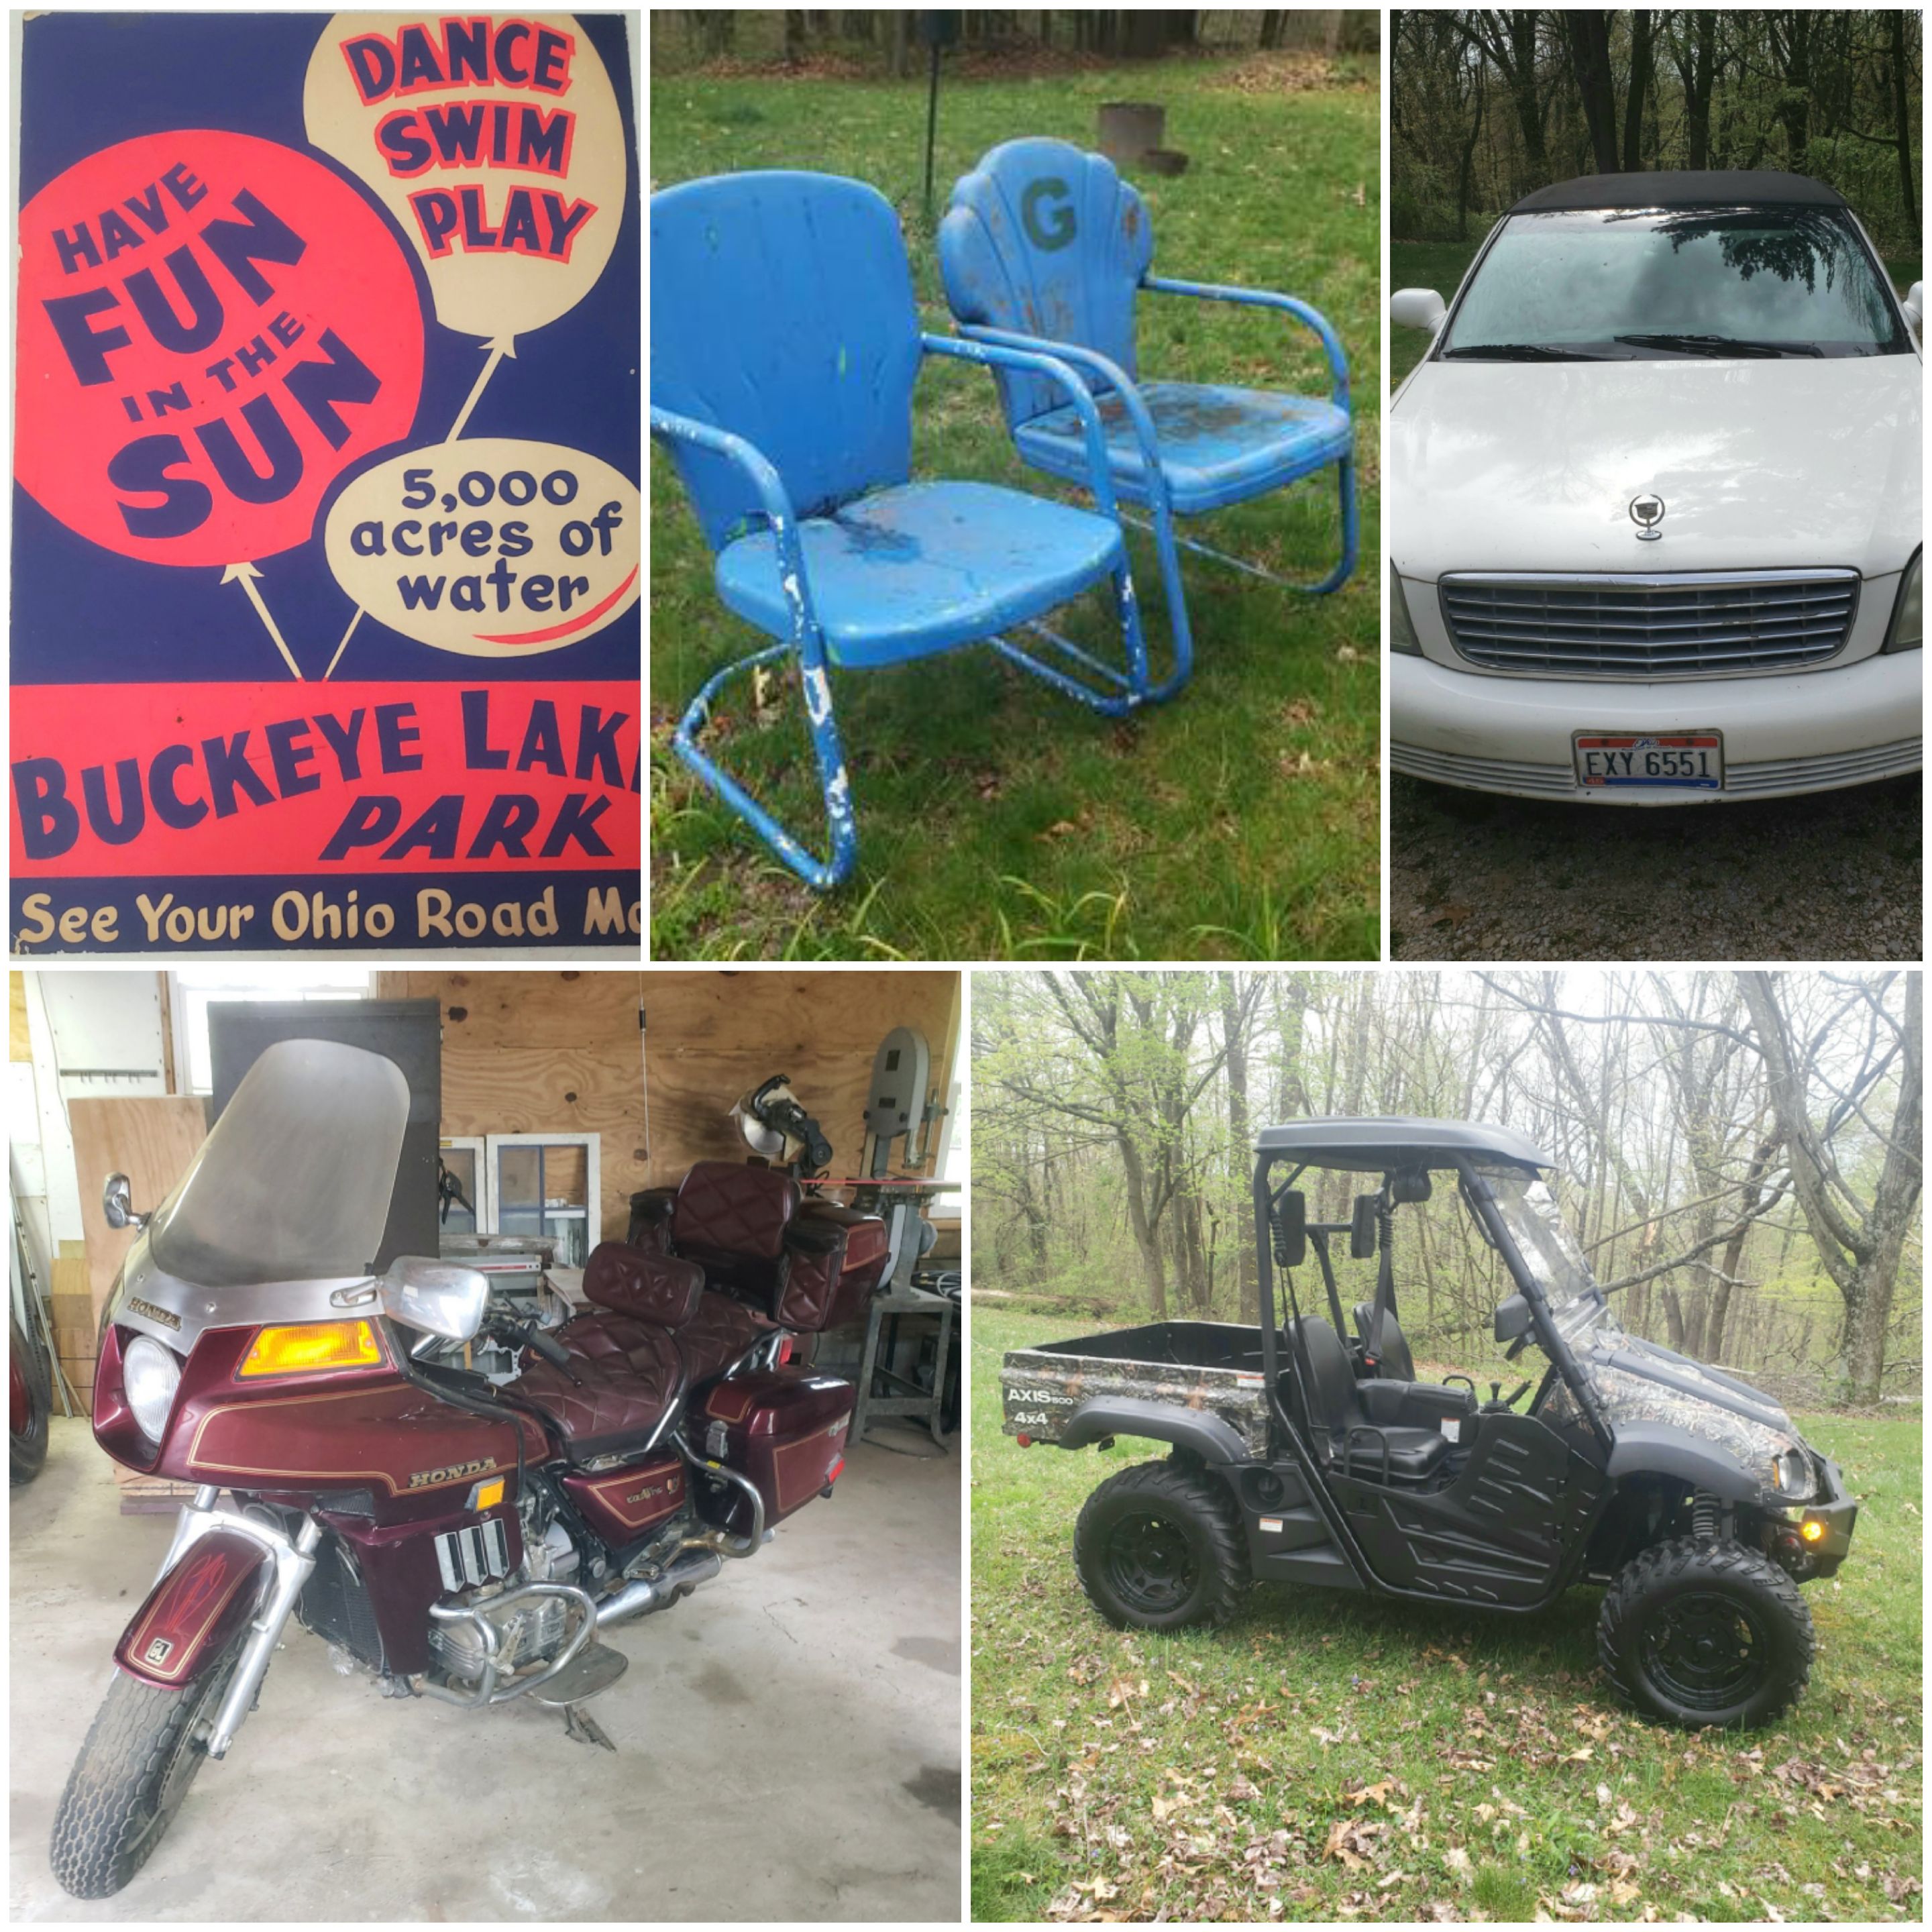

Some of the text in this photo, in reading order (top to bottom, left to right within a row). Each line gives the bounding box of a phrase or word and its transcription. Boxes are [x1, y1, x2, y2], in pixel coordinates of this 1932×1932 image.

[344, 19, 573, 102] DANCE
[377, 102, 574, 176] SWIM
[52, 162, 209, 274] HAVE
[411, 185, 593, 260] PLAY
[1021, 177, 1077, 254] G
[42, 188, 307, 387] FUN
[121, 311, 306, 423] IN THE
[107, 327, 382, 539] SUN
[402, 468, 579, 513] 5,000
[350, 500, 623, 557] acres of
[396, 557, 590, 612] water
[11, 690, 641, 860] BUCKEYE LAK
[1586, 751, 1710, 777] EXY 6551
[318, 794, 614, 860] PARK
[19, 894, 119, 944] See
[136, 893, 254, 943] Your
[272, 890, 395, 942] Ohio
[417, 886, 559, 937] Road
[1014, 1411, 1049, 1425] 4x4
[409, 1456, 497, 1488] HONDA
